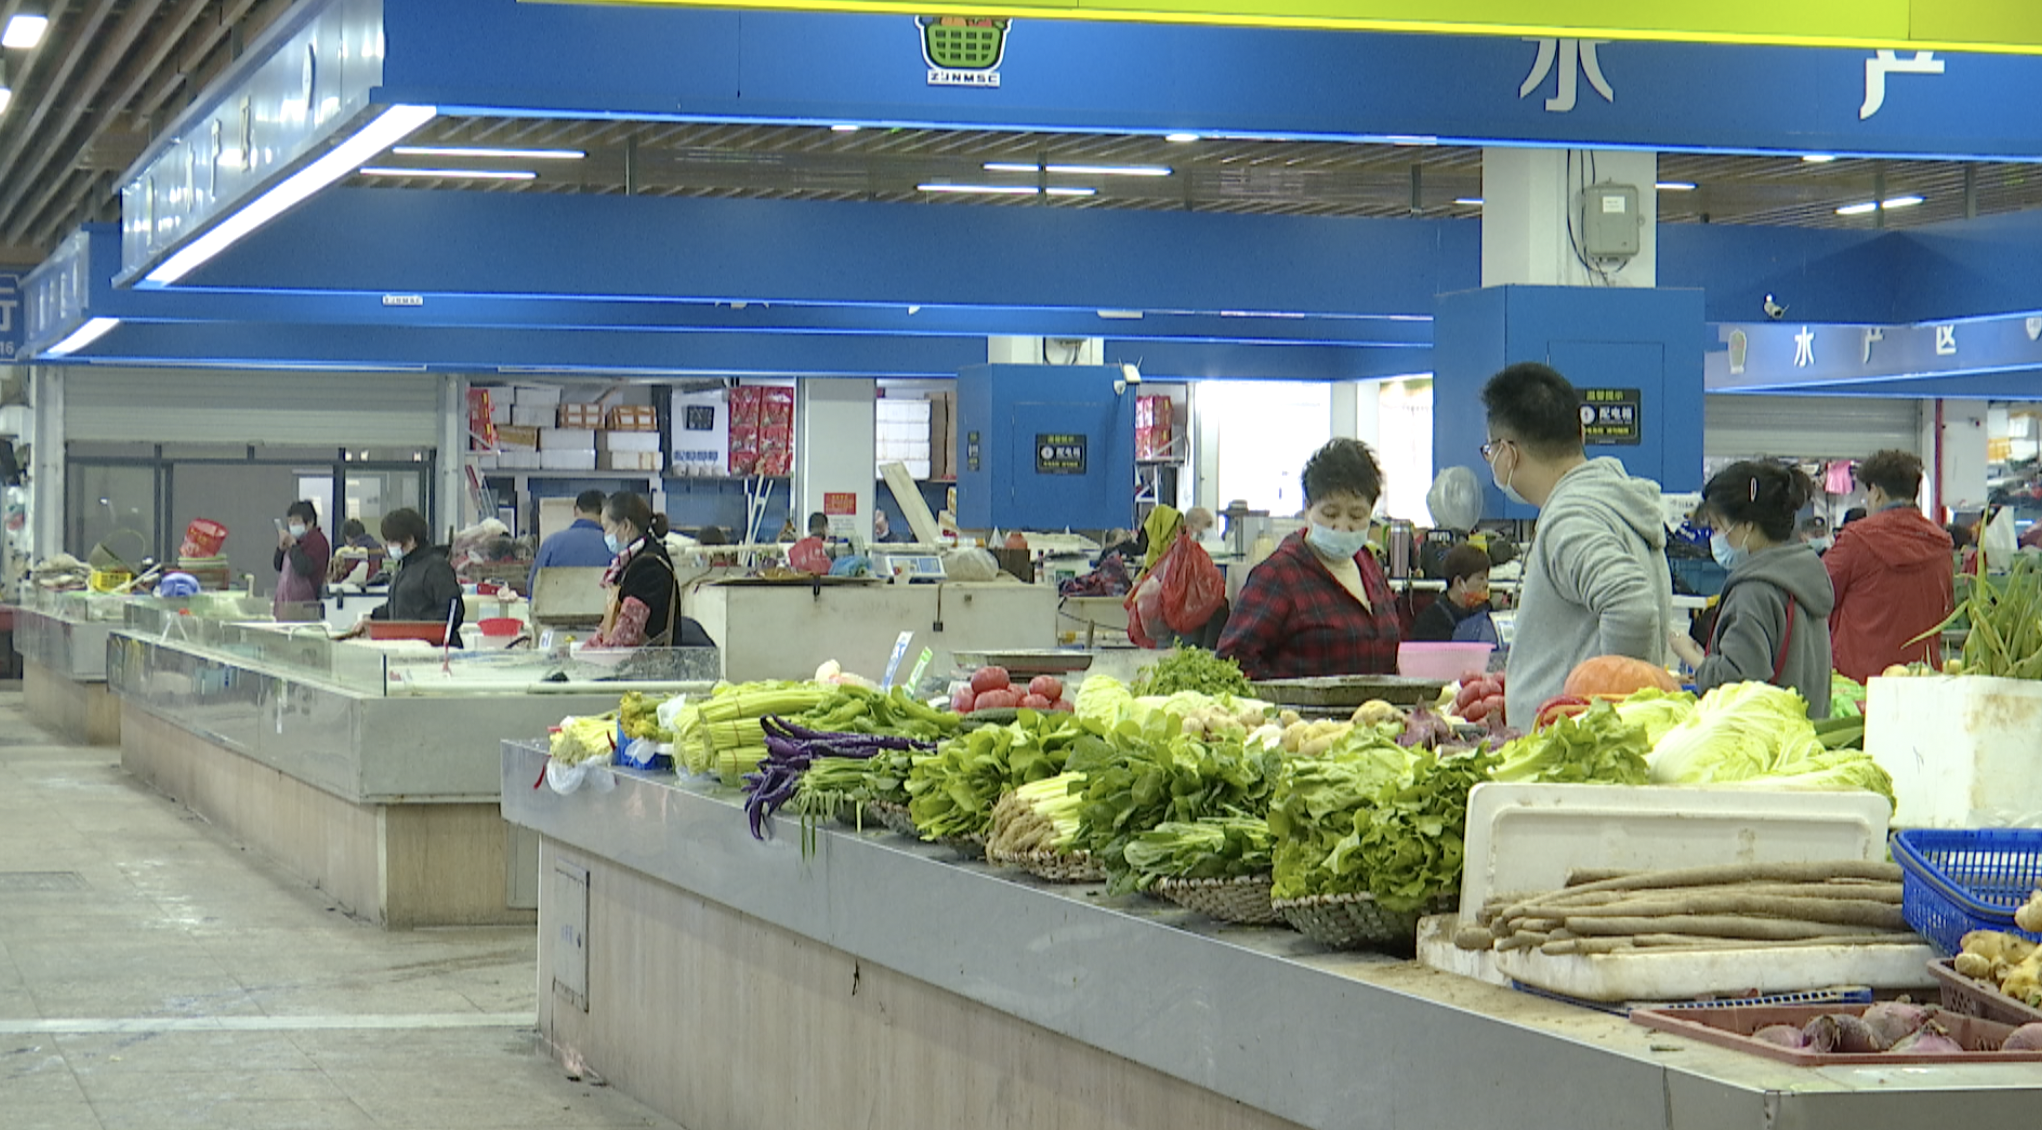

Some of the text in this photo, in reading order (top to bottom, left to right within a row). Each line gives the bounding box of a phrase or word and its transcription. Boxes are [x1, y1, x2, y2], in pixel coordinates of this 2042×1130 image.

[930, 72, 998, 84] ZJNMSC
[1794, 325, 1957, 367] 水产区
